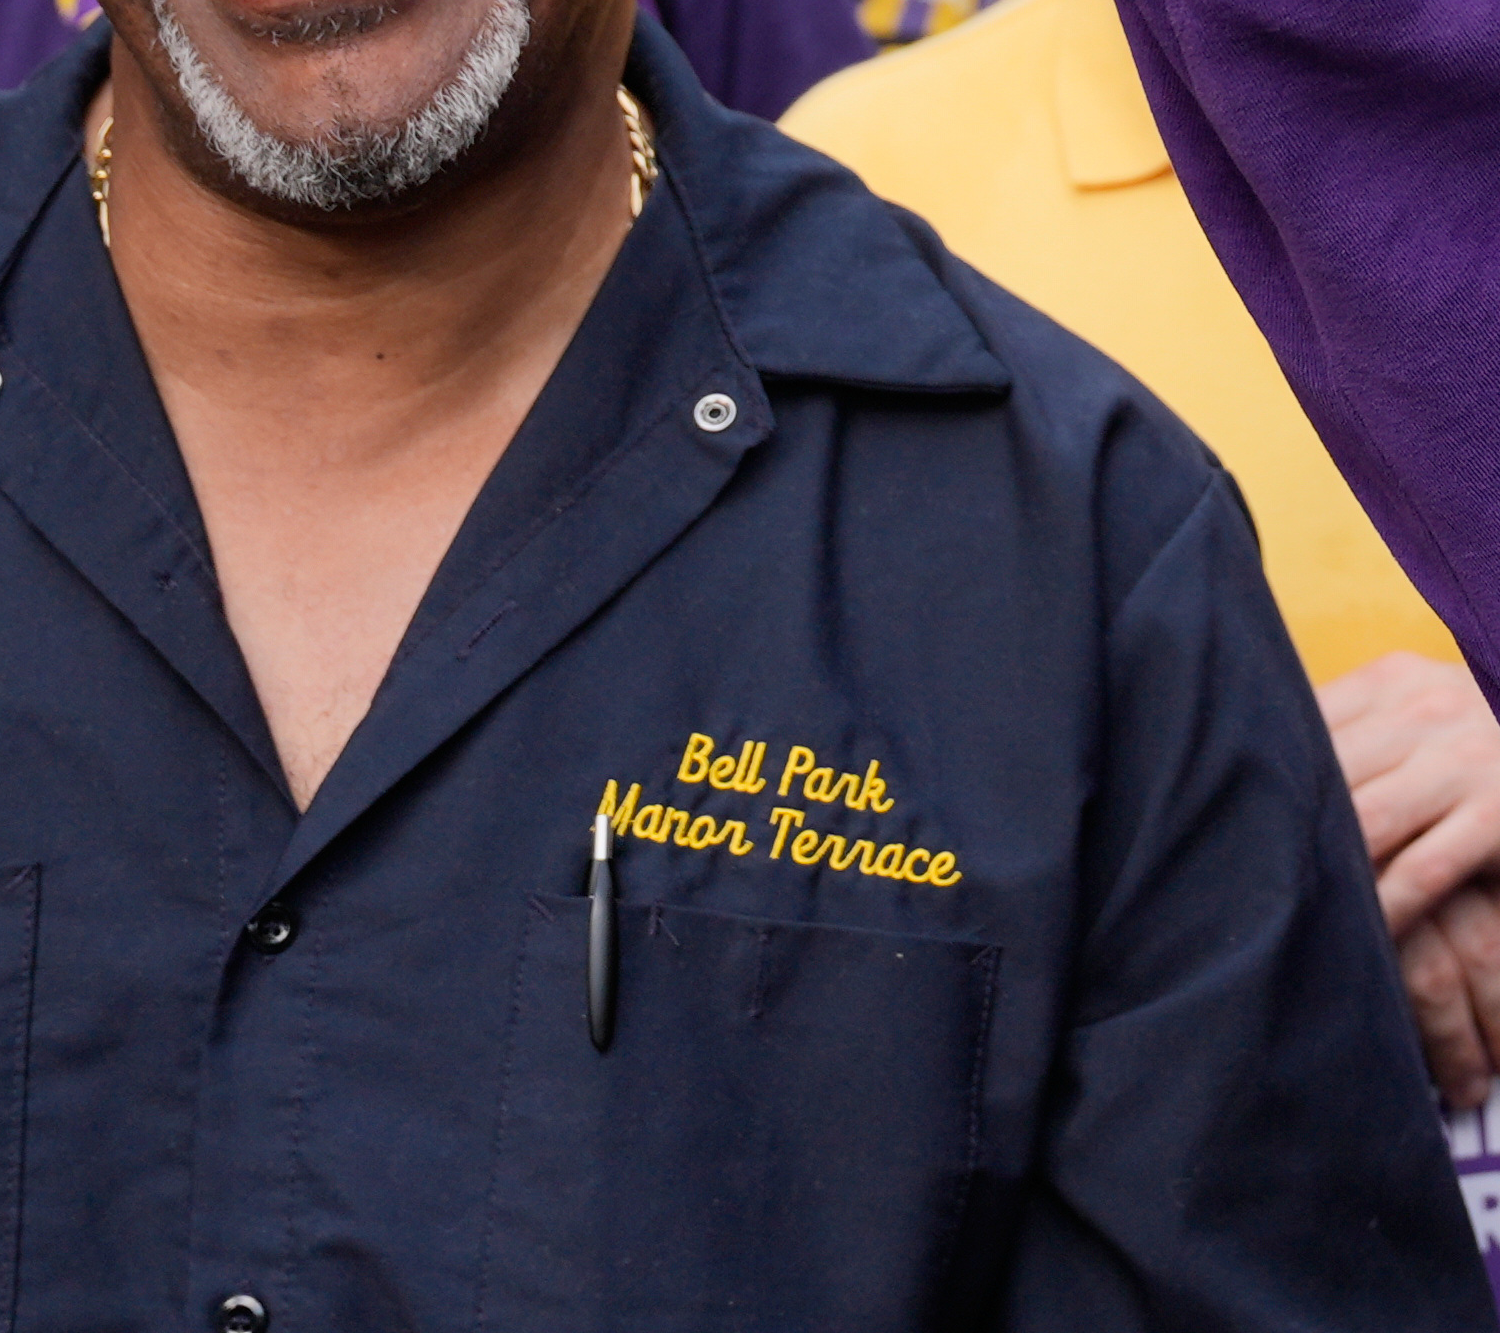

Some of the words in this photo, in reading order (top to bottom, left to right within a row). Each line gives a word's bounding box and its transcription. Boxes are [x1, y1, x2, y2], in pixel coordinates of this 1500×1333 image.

[676, 732, 767, 795] Bell
[777, 745, 895, 813] Park
[590, 778, 754, 856] Manor
[769, 807, 962, 887] Terrace
